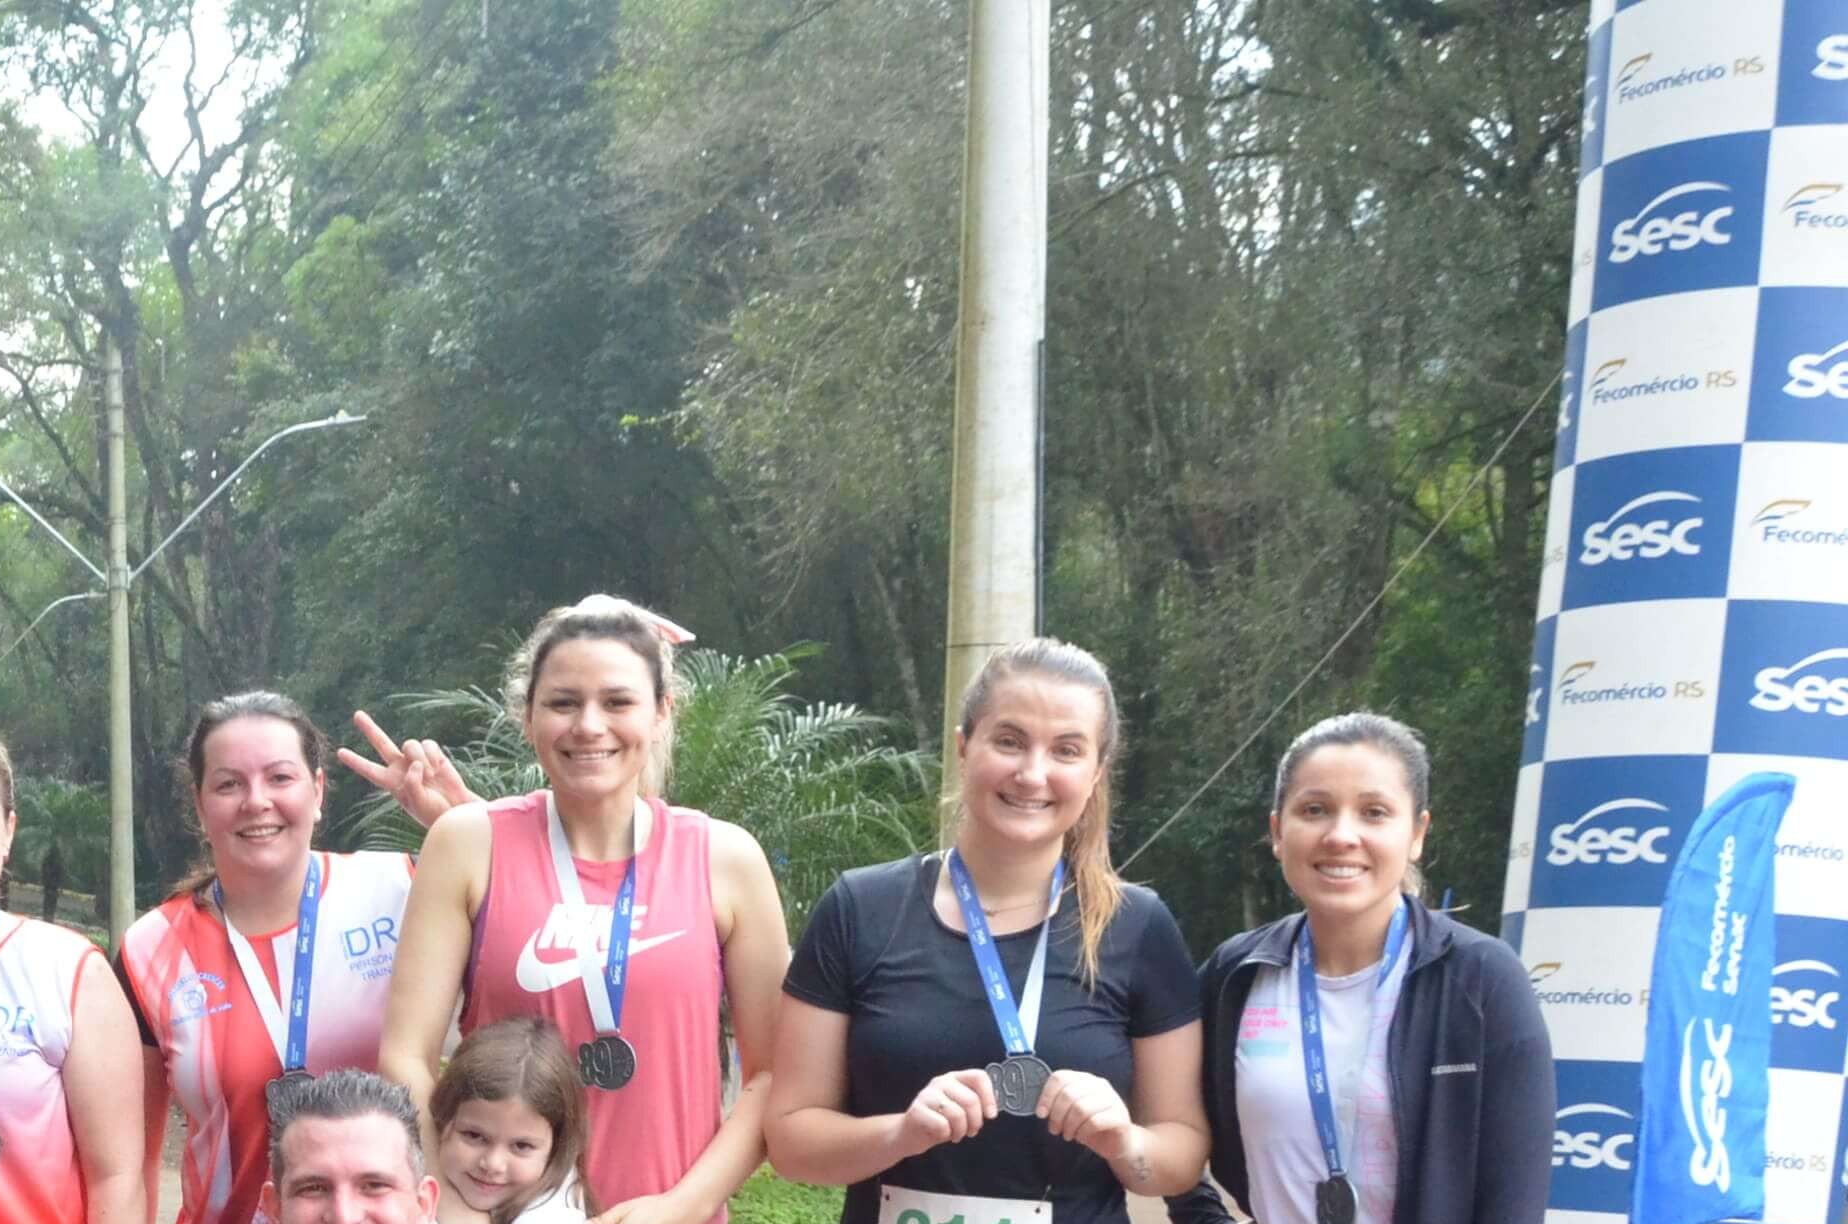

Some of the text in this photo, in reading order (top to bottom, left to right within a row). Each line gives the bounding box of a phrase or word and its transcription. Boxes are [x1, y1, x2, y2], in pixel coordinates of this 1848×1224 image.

[1618, 55, 1765, 104] Fecomércio RS
[1591, 374, 1699, 405] Fecomércio
[1706, 370, 1737, 389] RS
[1561, 681, 1705, 705] Fecomércio RS
[344, 917, 398, 956] DR
